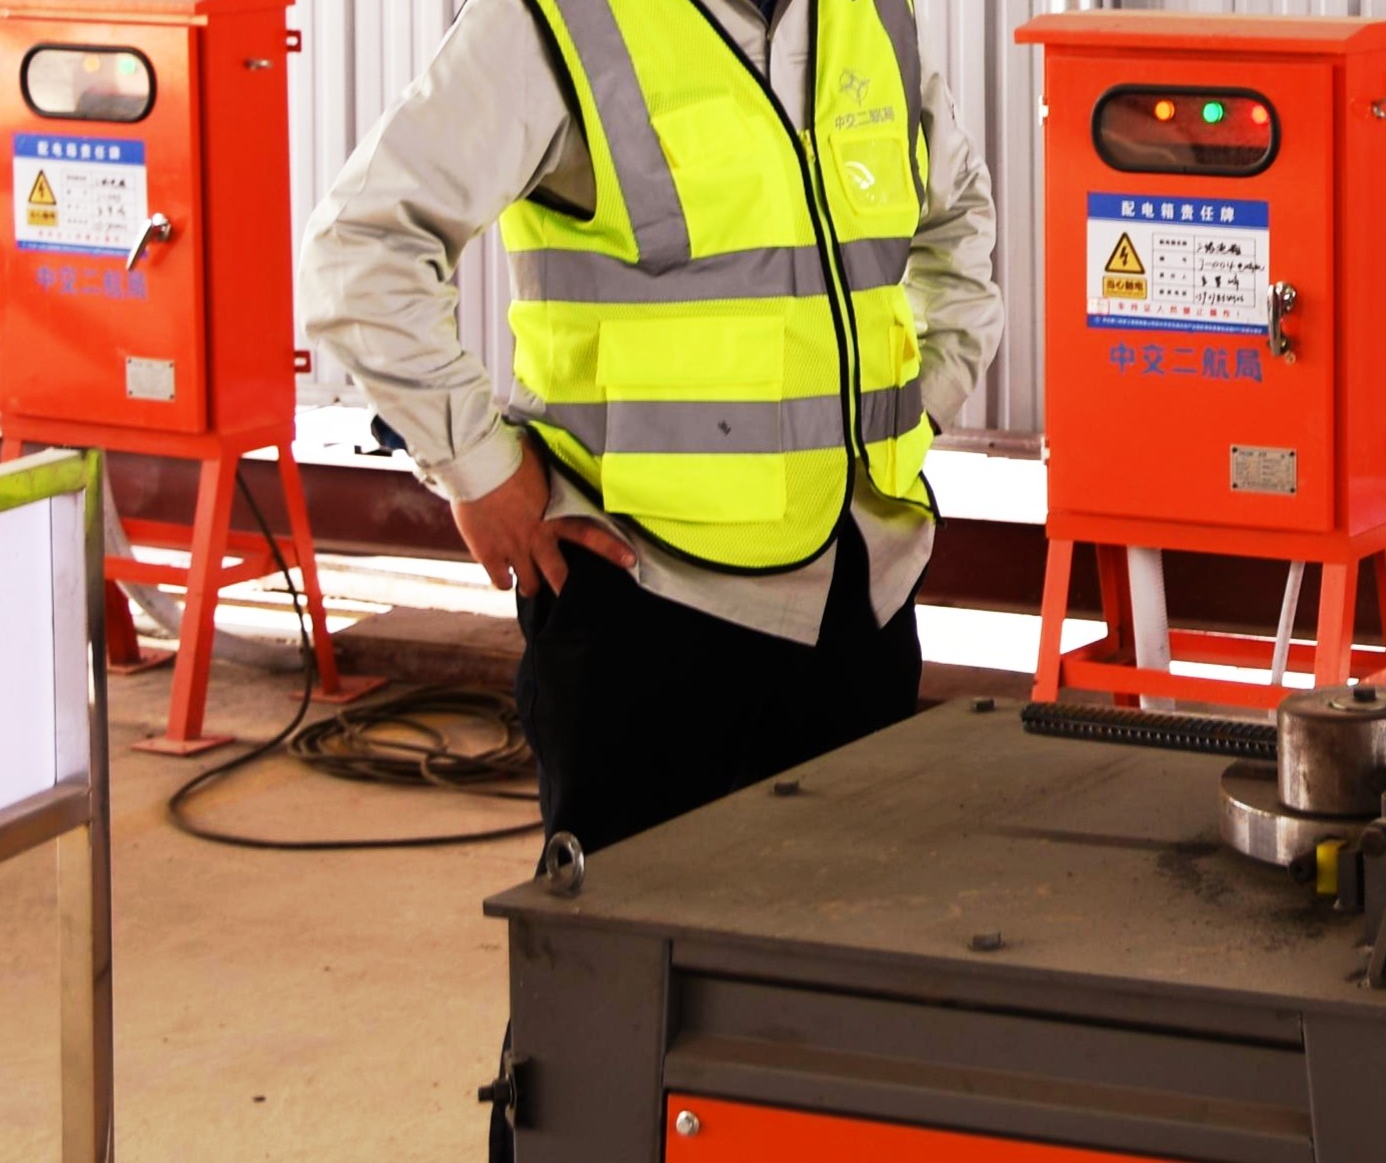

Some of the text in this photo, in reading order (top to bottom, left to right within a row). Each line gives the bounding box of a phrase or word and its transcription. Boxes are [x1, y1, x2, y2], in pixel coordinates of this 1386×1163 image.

[1121, 201, 1235, 222] 配电箱责任牌
[1109, 342, 1262, 382] 中交二航局
